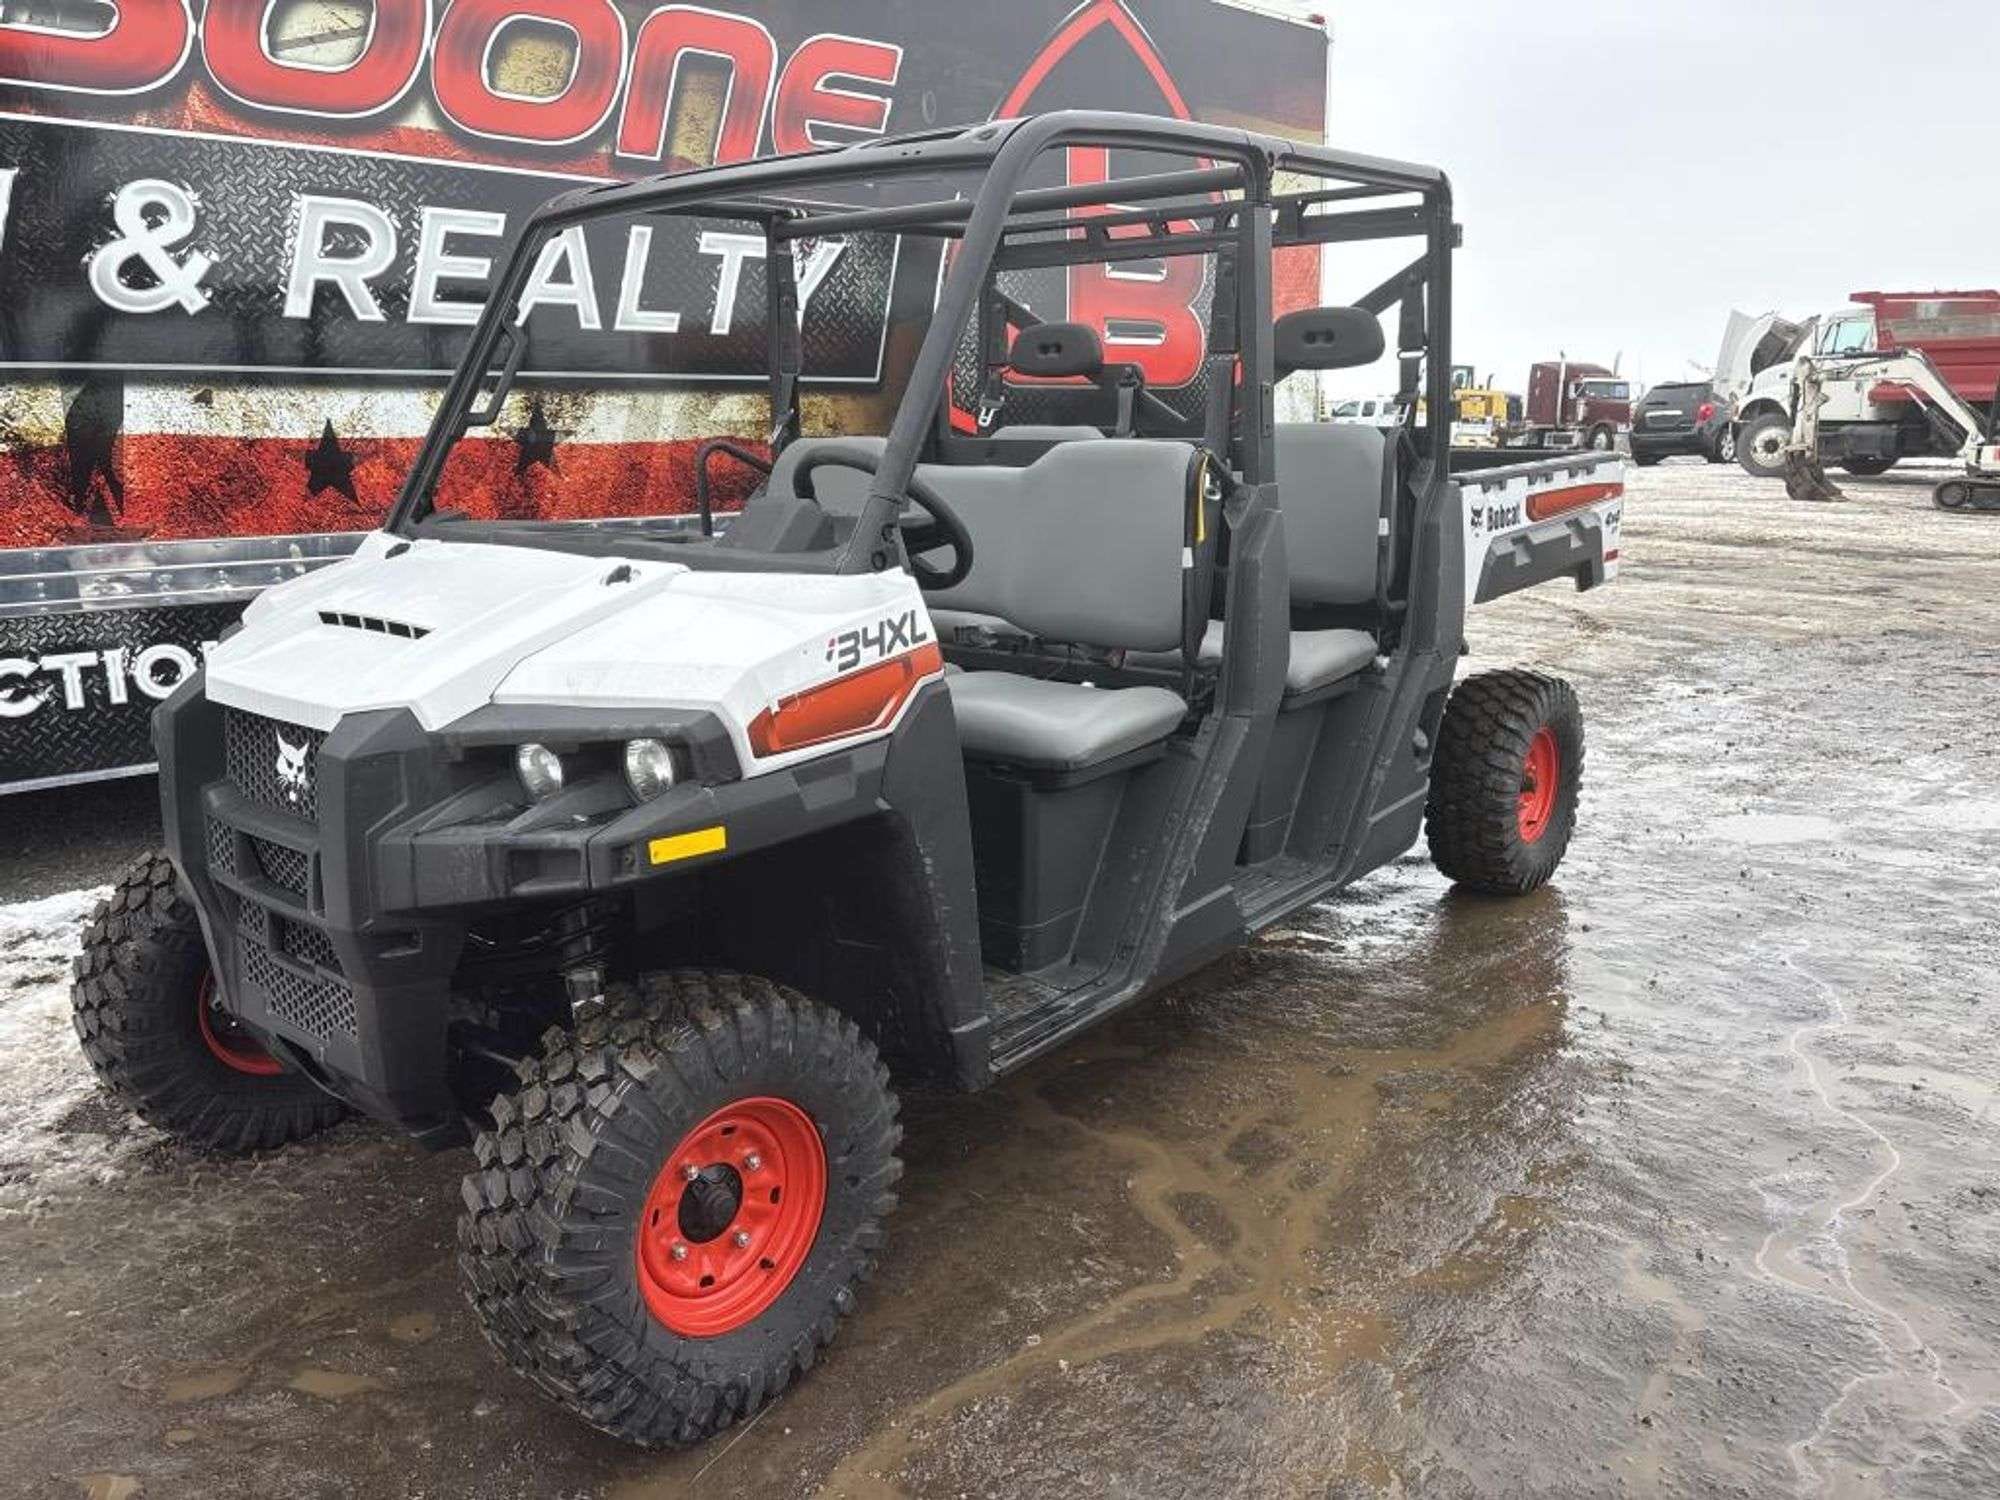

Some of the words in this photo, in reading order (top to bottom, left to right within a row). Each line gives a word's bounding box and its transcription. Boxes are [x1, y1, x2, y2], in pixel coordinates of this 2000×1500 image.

[88, 178, 212, 317] &
[283, 192, 847, 335] REALTY
[0, 641, 218, 717] CTIO
